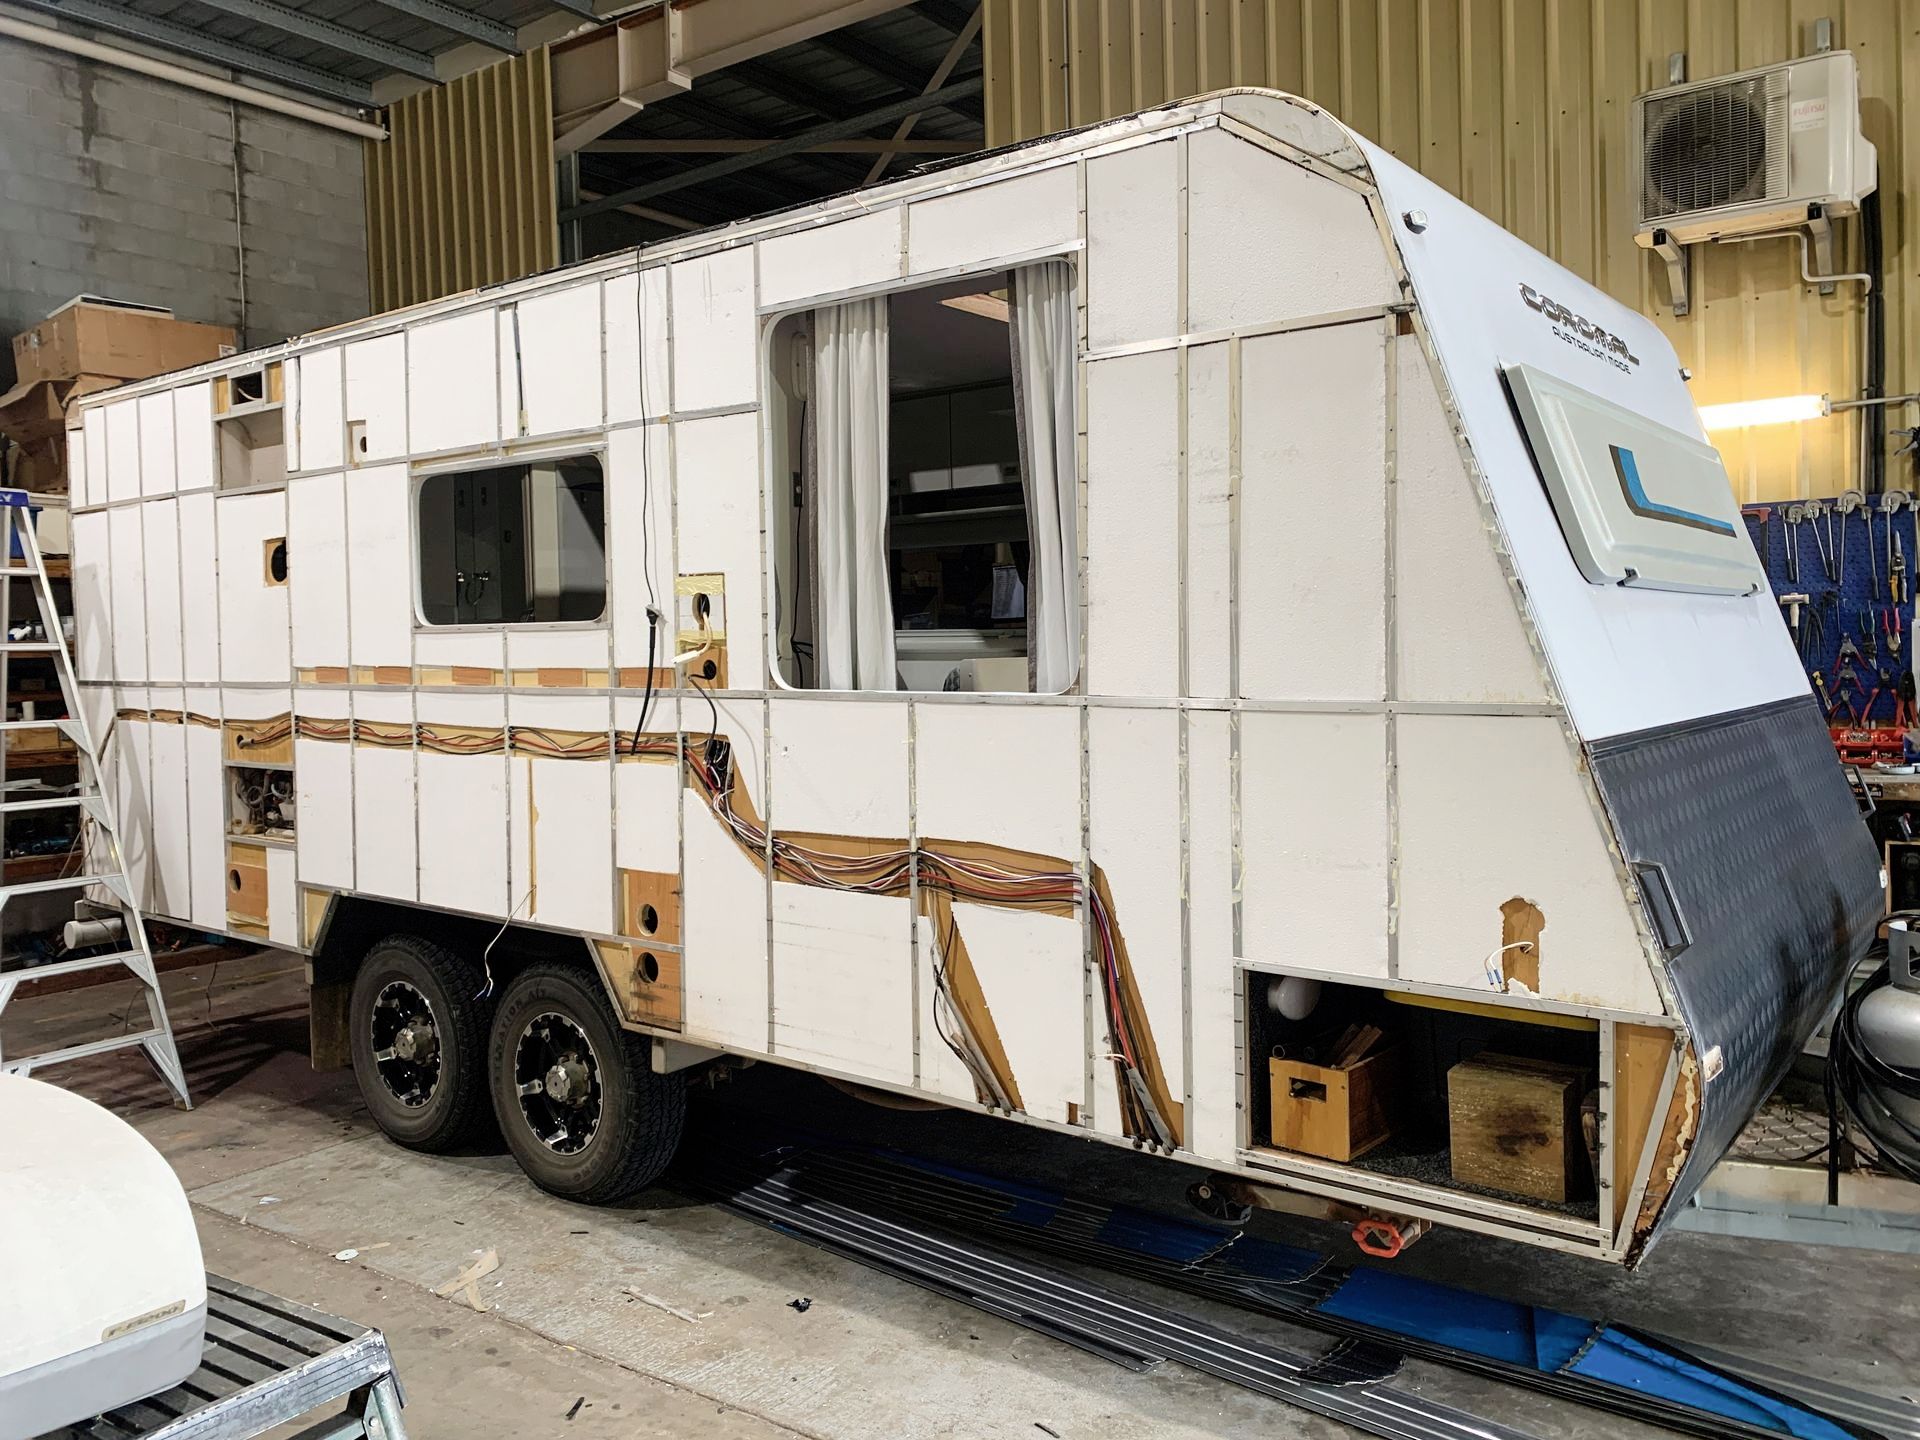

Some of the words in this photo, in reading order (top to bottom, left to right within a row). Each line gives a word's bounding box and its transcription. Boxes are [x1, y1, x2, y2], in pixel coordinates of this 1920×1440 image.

[1793, 104, 1825, 116] FUJITSU
[1518, 282, 1640, 366] COROMAL
[1551, 325, 1608, 363] AUSTRALIAN
[1607, 355, 1632, 375] MADE
